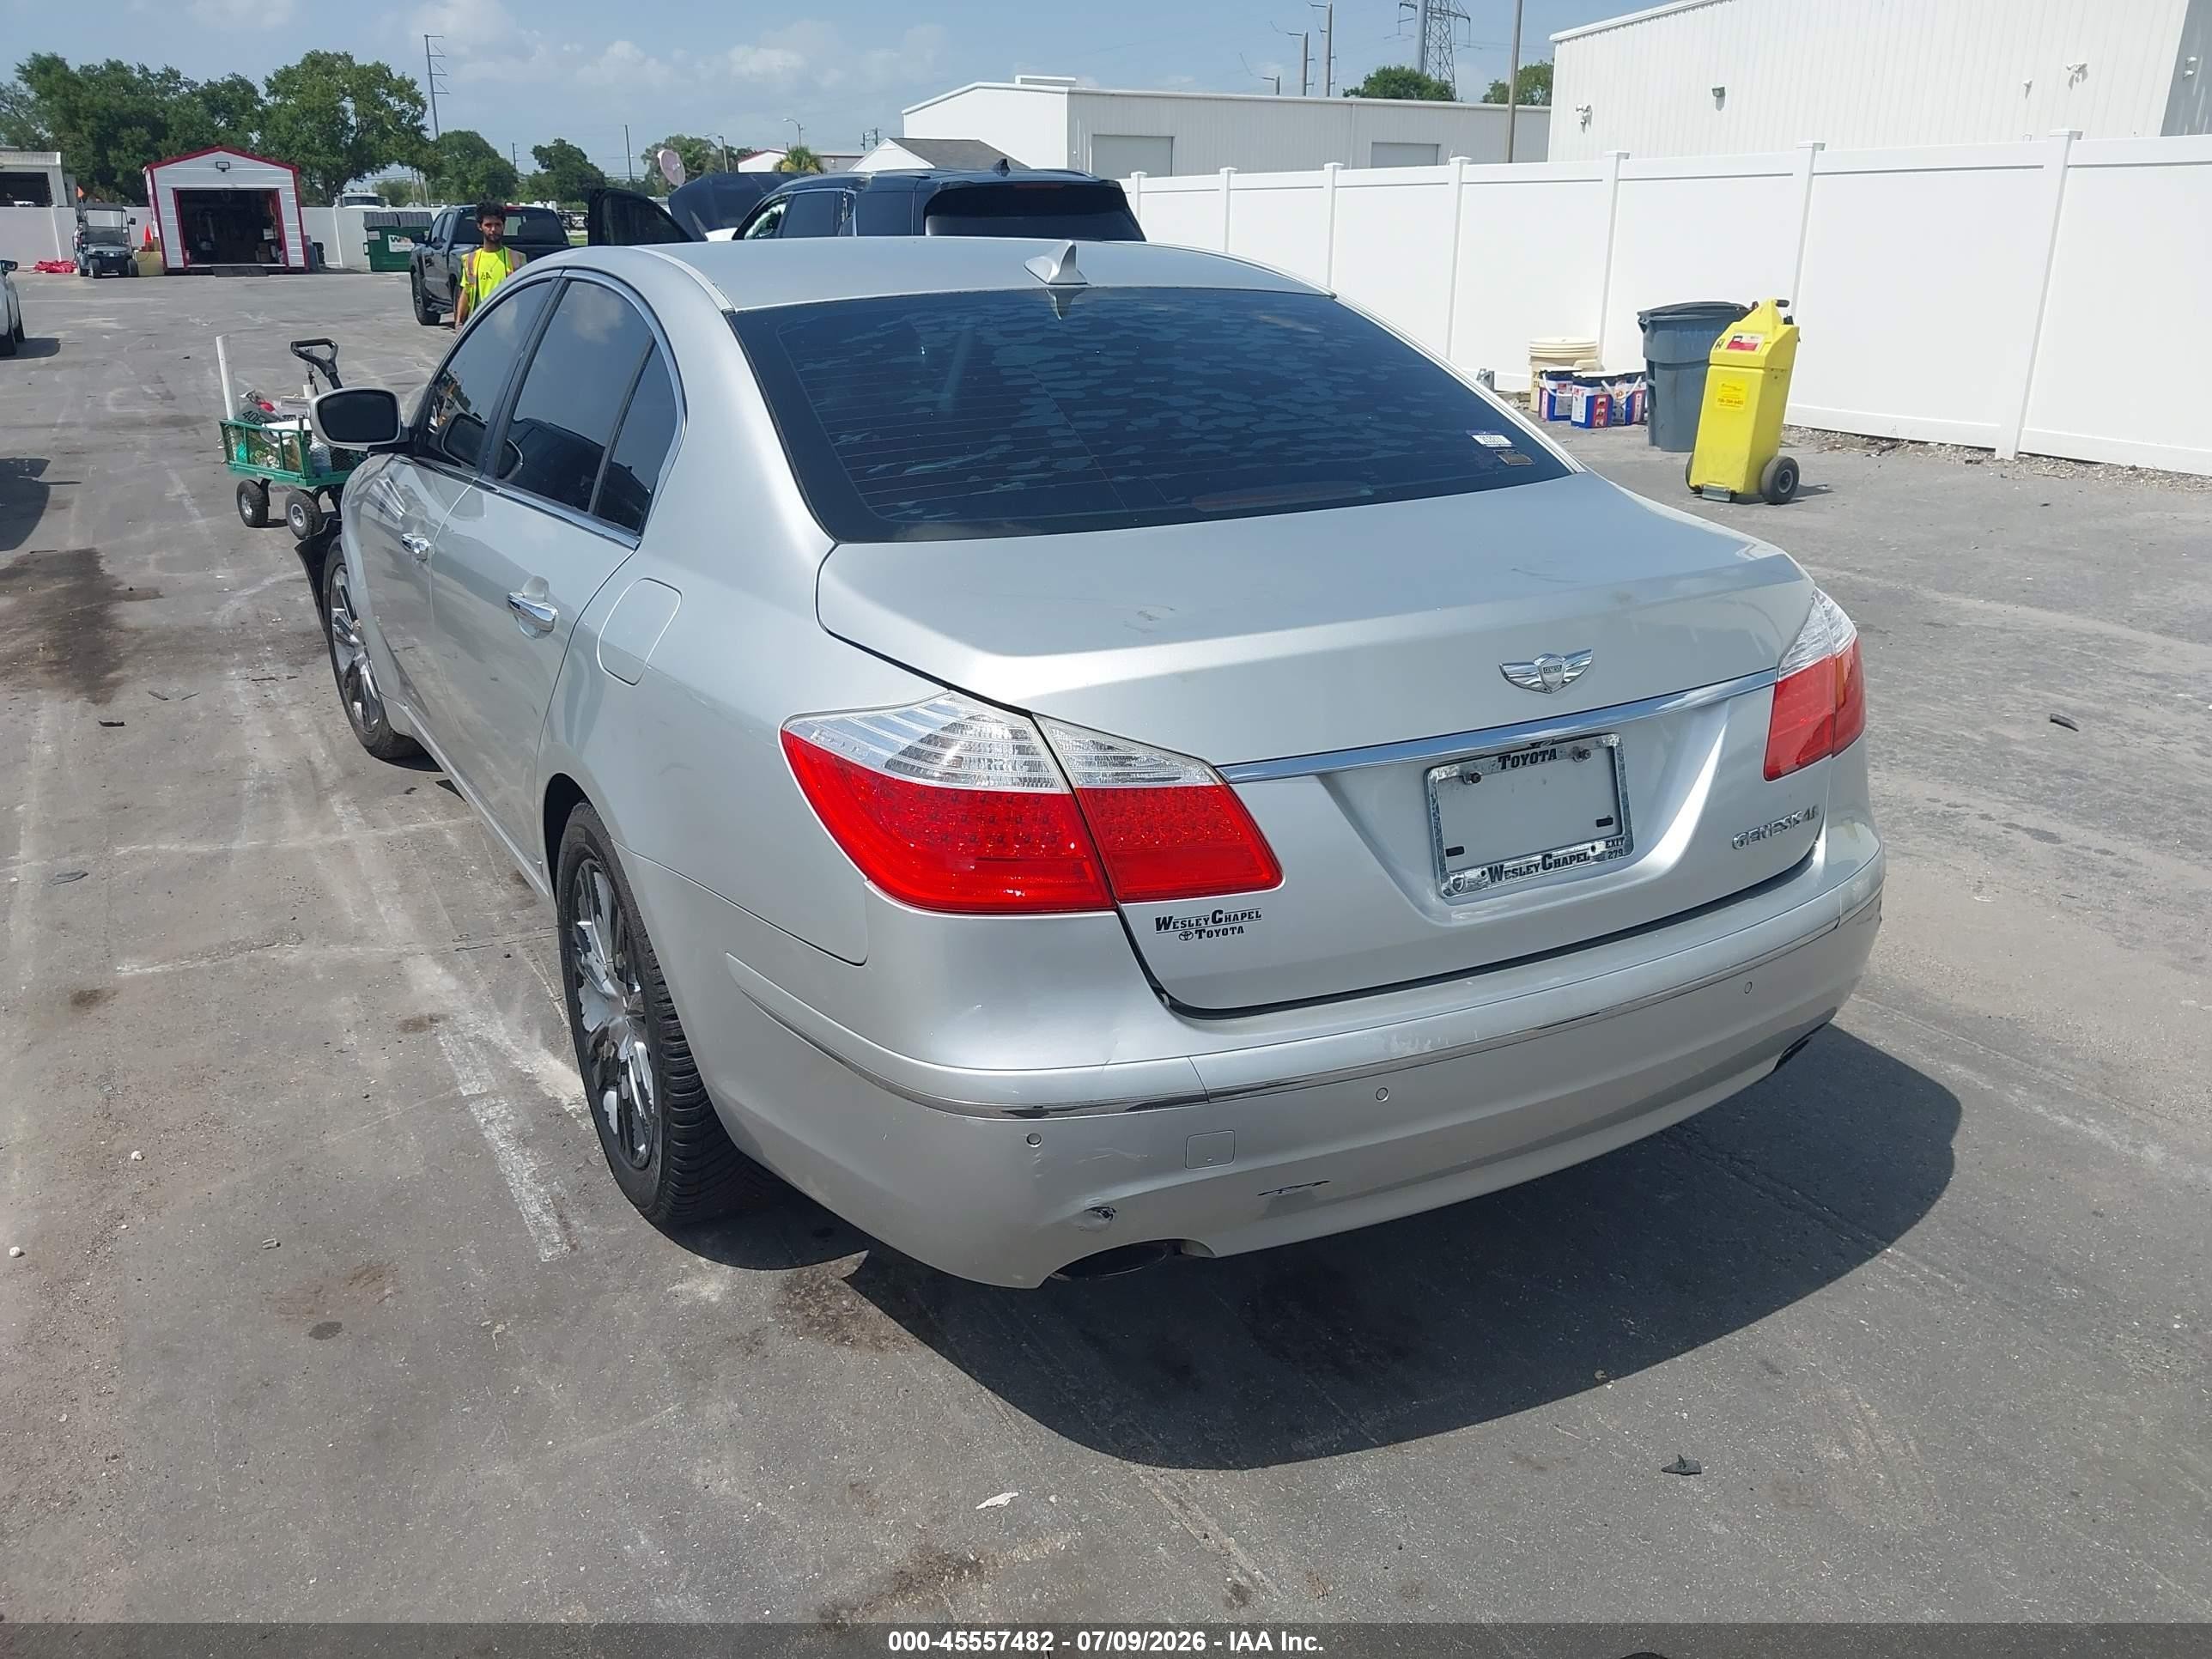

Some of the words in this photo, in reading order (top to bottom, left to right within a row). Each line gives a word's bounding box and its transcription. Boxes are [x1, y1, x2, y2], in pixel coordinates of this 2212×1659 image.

[1498, 748, 1558, 770] TOYOTA
[1732, 811, 1802, 849] GENESIS
[1605, 837, 1626, 849] EXIT
[1607, 848, 1623, 860] 279
[1486, 862, 1541, 884] WESLEY
[1540, 851, 1590, 872] CHAPEL
[1155, 915, 1210, 931] WESLEY
[1211, 909, 1261, 925] CHAPEL
[1194, 926, 1244, 939] TOYOTA
